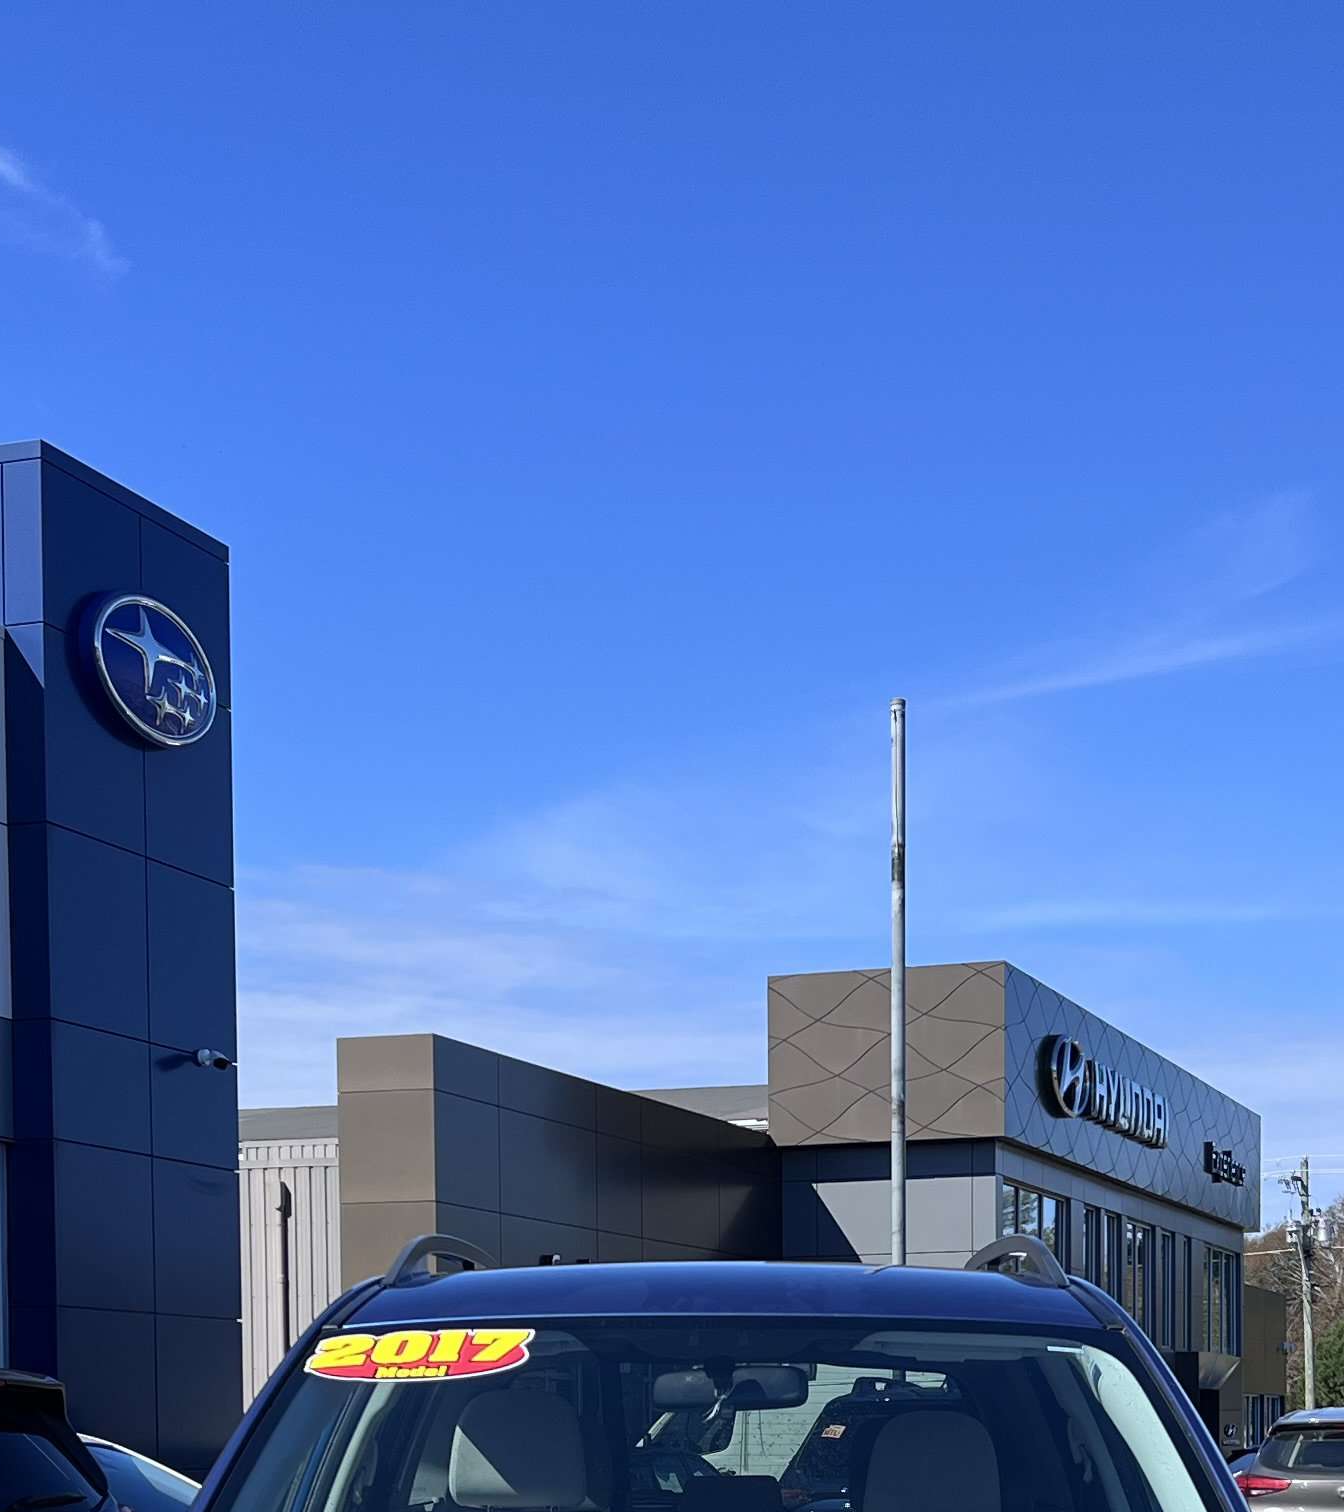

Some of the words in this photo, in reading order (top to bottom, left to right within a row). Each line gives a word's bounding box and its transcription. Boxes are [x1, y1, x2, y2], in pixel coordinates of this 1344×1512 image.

[1092, 1060, 1170, 1149] HYUNDAI
[308, 1330, 532, 1370] 2017
[375, 1365, 449, 1379] Model
